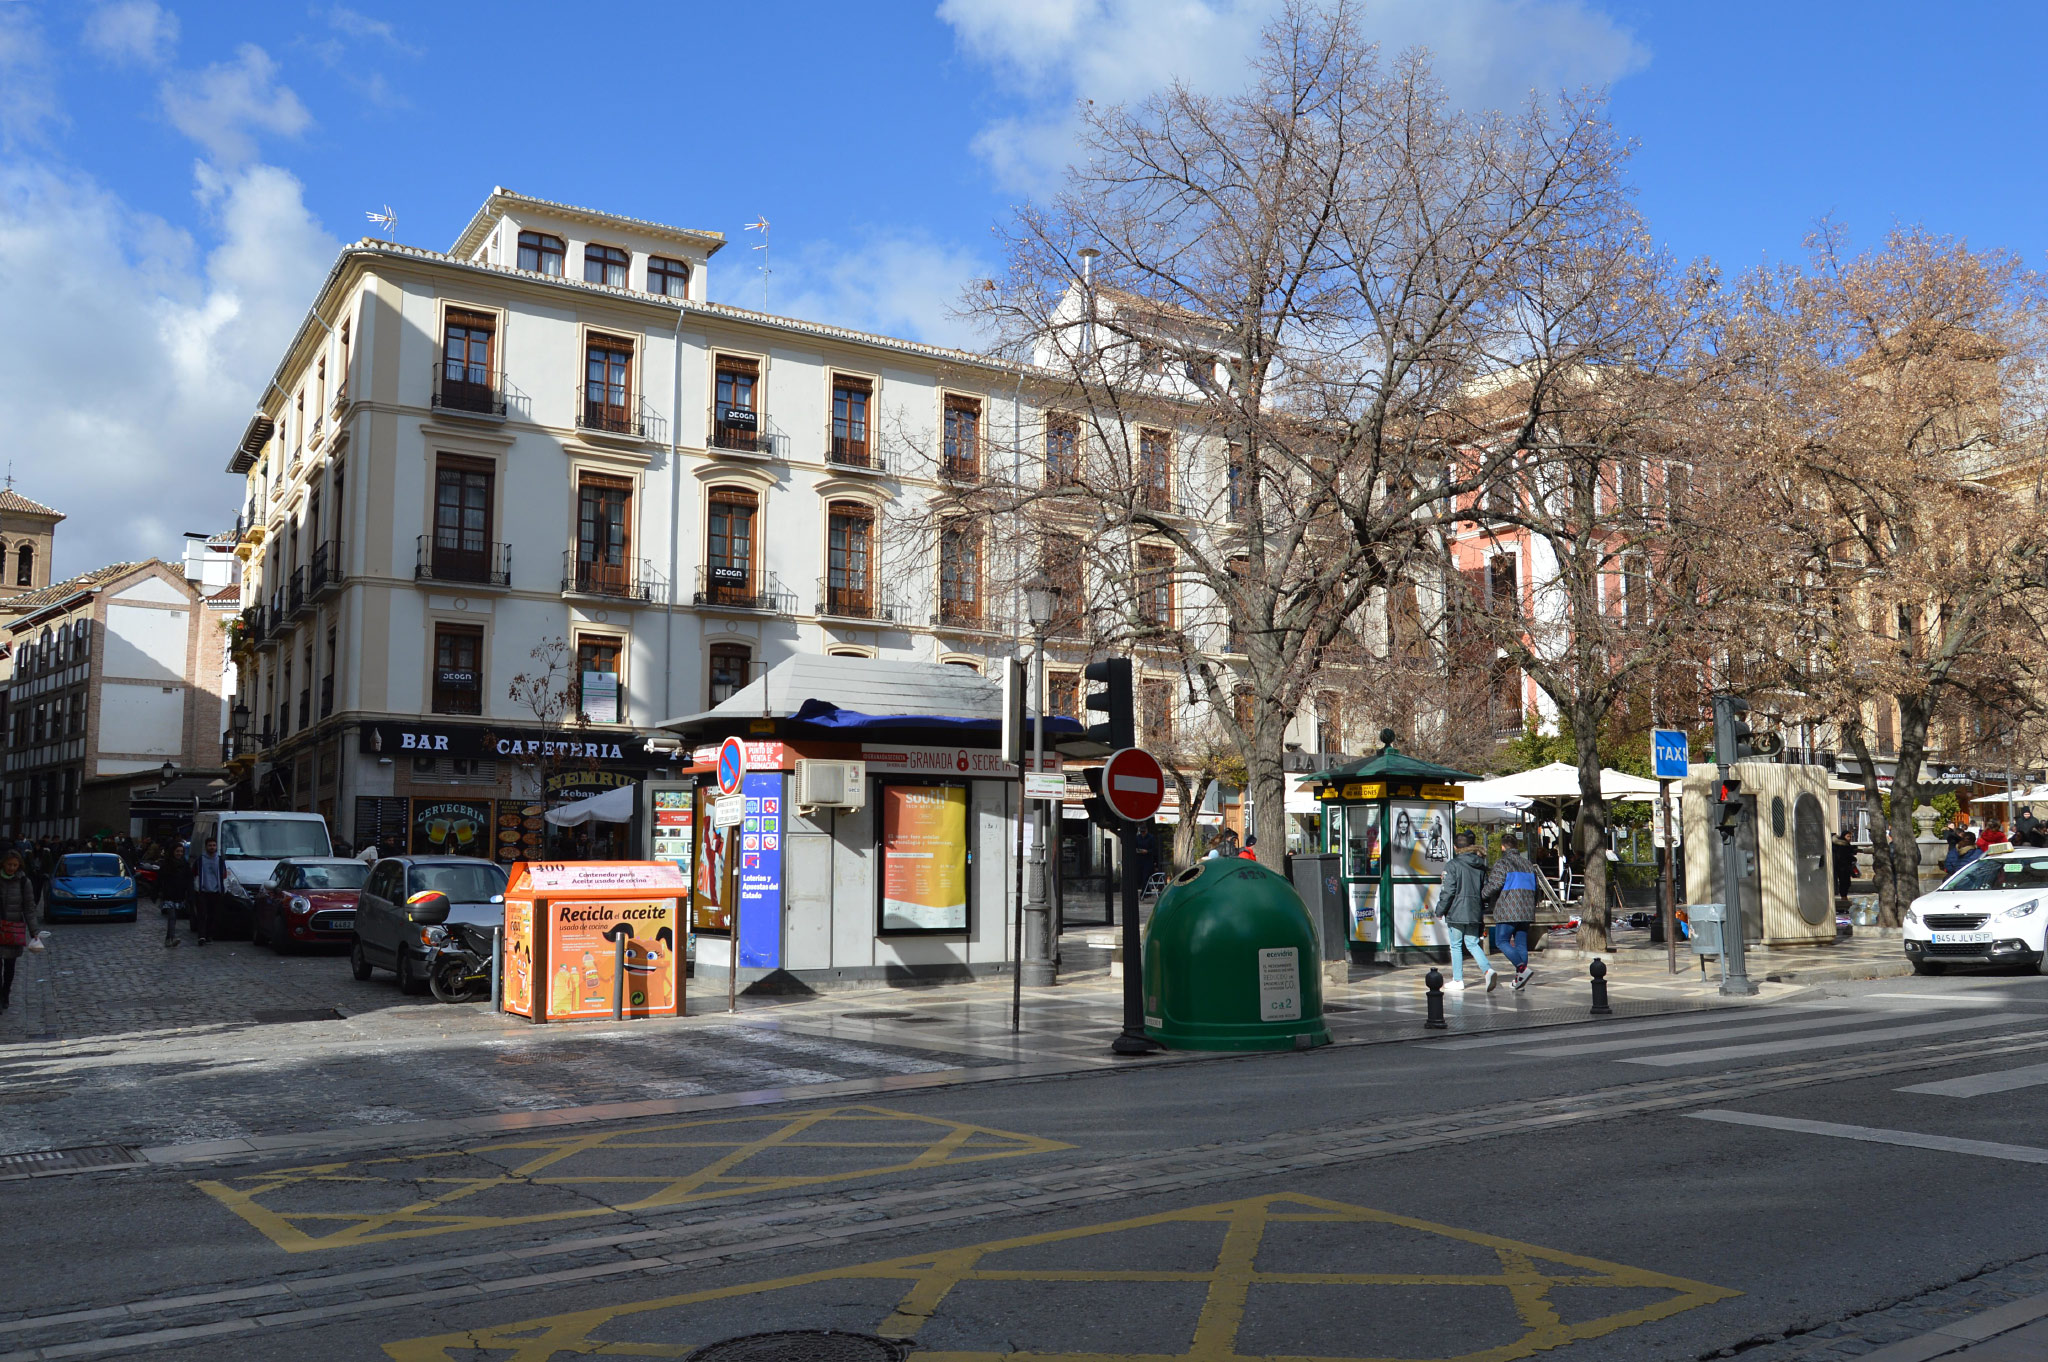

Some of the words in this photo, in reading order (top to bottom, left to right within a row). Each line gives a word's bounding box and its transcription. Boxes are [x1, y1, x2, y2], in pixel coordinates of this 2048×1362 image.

[402, 733, 449, 751] BAR
[496, 739, 624, 759] CAFETERIA
[748, 747, 766, 755] PUNTO
[766, 747, 773, 755] DE
[1656, 746, 1688, 762] TAXI
[750, 754, 766, 762] VENTA
[910, 751, 953, 769] GRANADA
[905, 789, 945, 805] south
[417, 803, 485, 823] CERVECERIA
[619, 872, 636, 880] para
[742, 883, 768, 891] Apuestas
[769, 882, 778, 890] del
[742, 891, 762, 899] Estado
[559, 906, 613, 922] Recicla
[622, 905, 666, 920] aceite
[1356, 908, 1375, 918] Rascas
[334, 920, 351, 929] 4482
[1936, 933, 1956, 943] 9454
[1959, 933, 1974, 943] JLV
